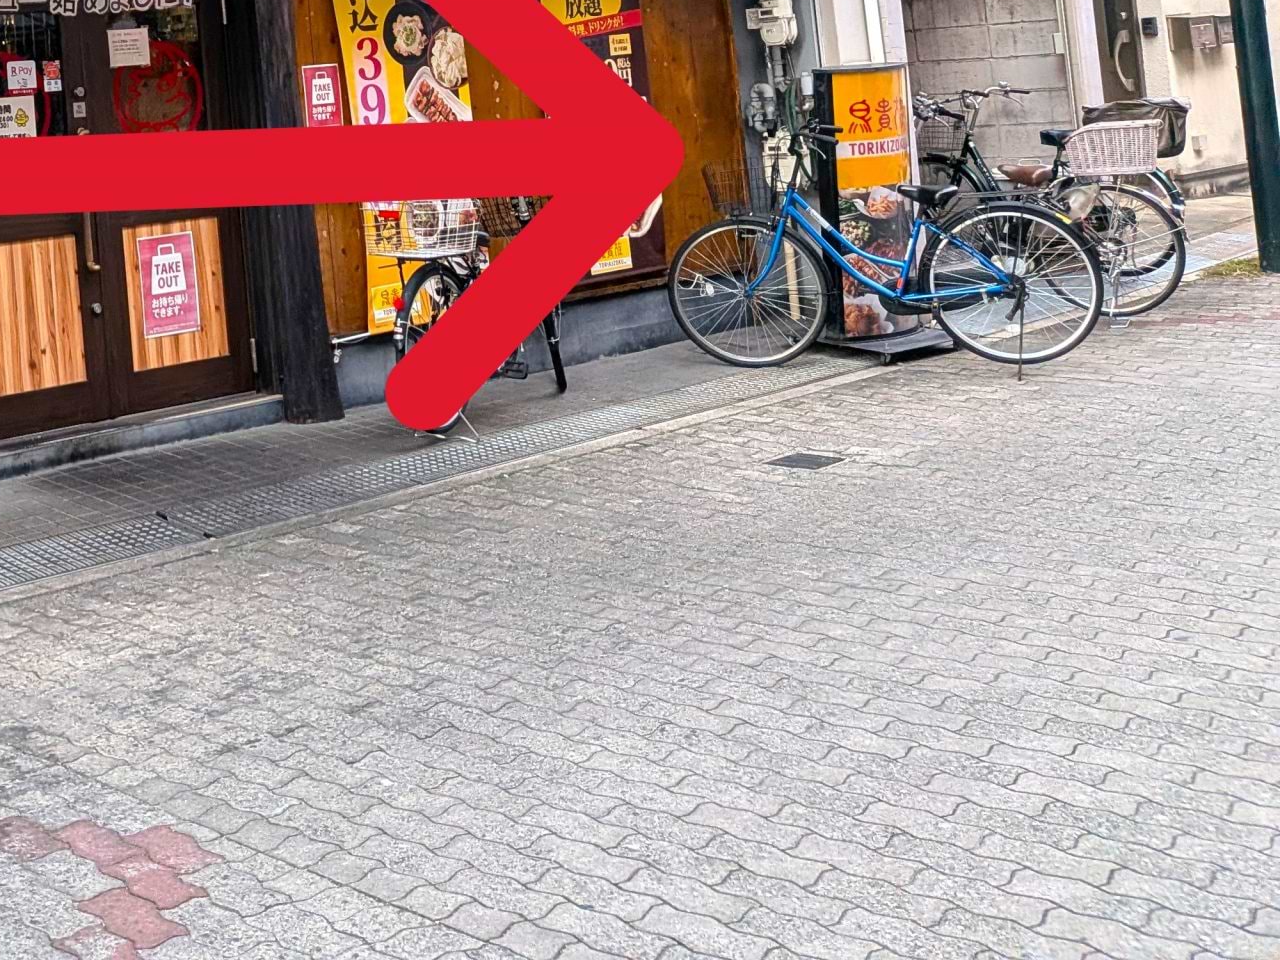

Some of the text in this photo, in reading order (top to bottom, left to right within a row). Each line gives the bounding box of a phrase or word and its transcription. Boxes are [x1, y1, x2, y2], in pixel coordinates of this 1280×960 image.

[314, 83, 331, 92] TAKE
[316, 93, 330, 101] OUT
[154, 261, 182, 276] TAKE
[157, 275, 180, 289] OUT
[152, 294, 188, 308] お持ち帰り
